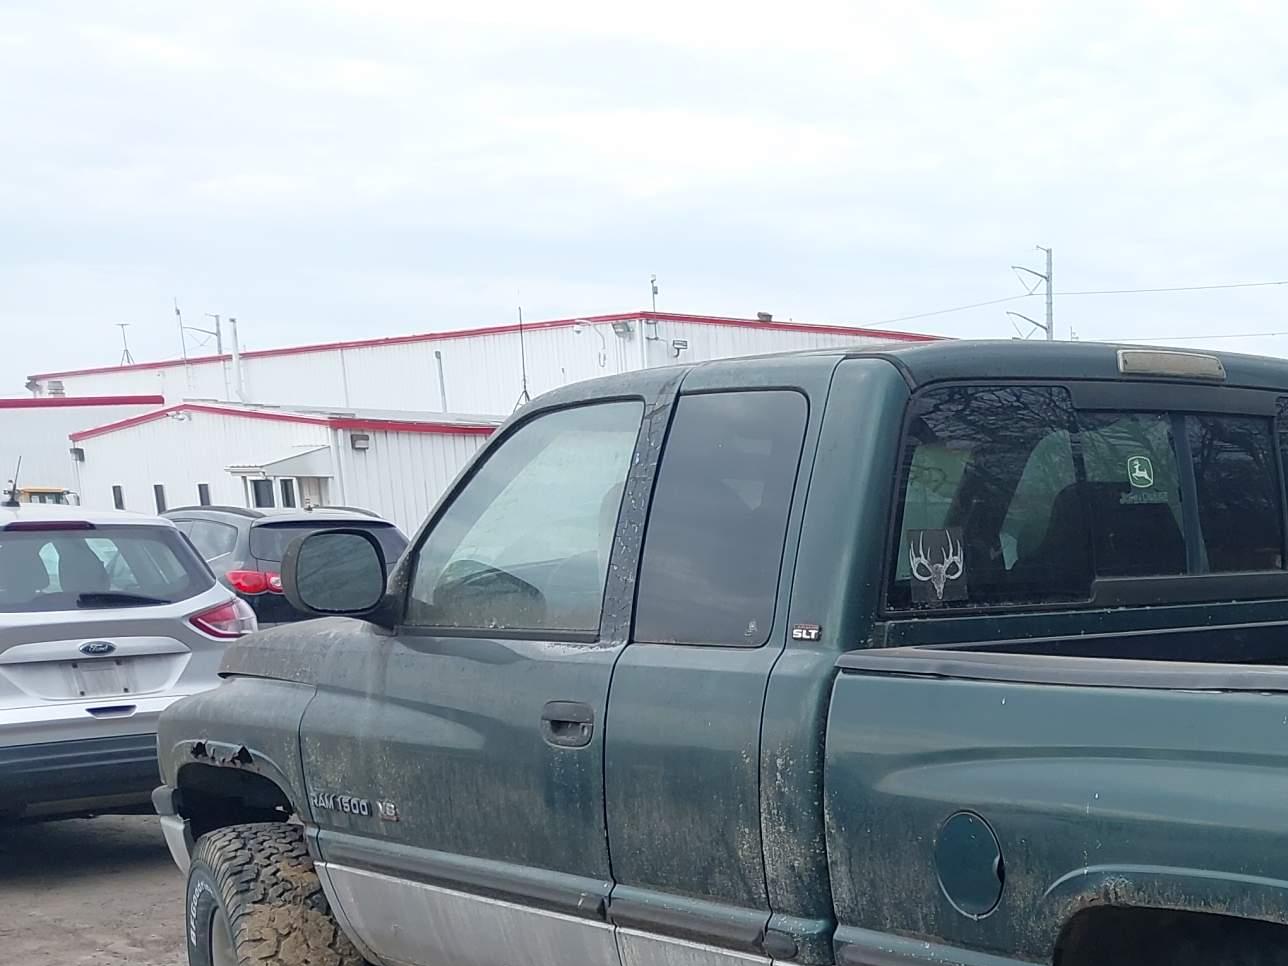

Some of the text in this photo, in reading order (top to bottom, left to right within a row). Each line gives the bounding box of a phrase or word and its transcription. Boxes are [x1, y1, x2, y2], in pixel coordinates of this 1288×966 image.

[792, 629, 819, 639] SLT
[310, 792, 336, 810] RAM
[336, 794, 369, 816] 1500
